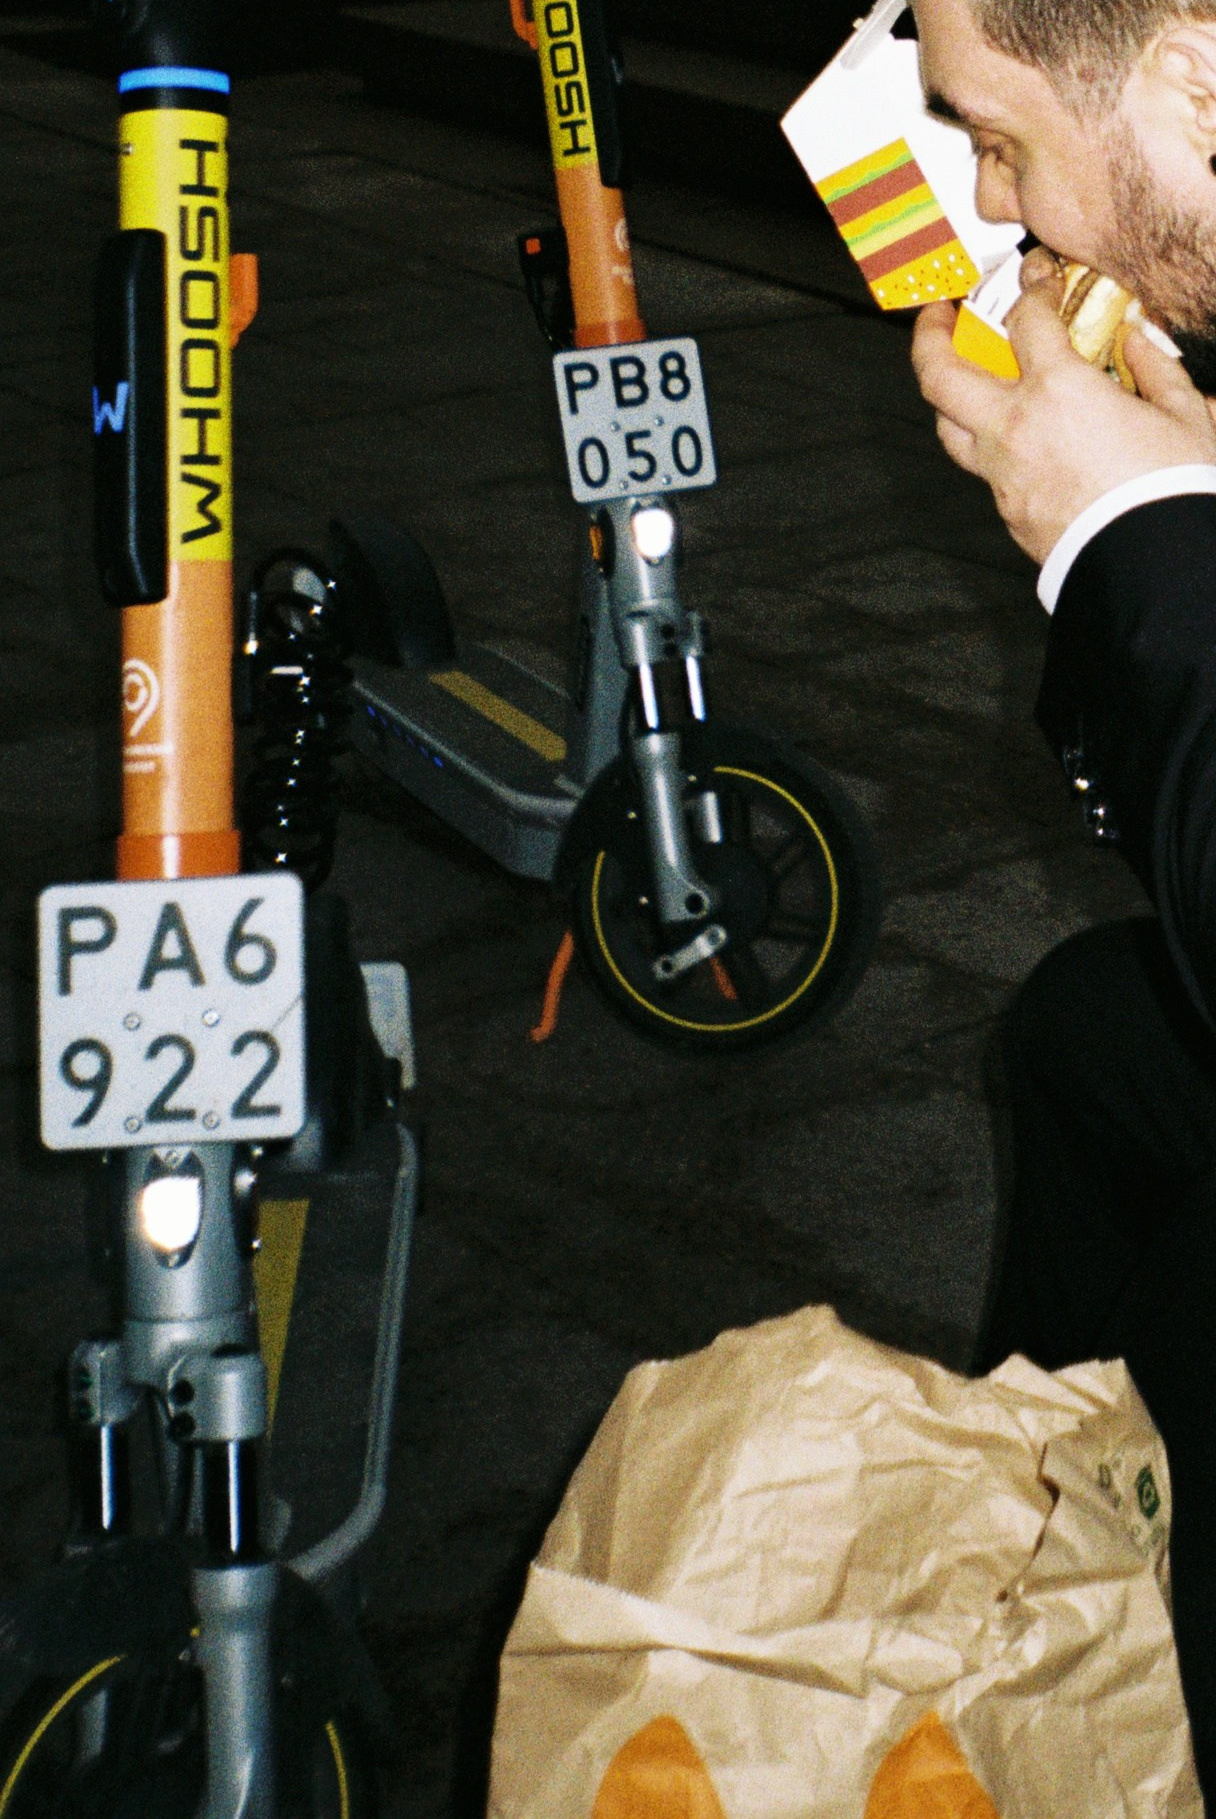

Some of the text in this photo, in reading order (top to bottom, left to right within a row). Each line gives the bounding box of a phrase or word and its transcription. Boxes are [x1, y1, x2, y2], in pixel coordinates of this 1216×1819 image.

[178, 138, 223, 543] WHOOSH
[92, 381, 129, 434] W
[563, 350, 691, 415] PB8
[577, 425, 703, 489] 050
[58, 898, 277, 996] PA6
[60, 1030, 281, 1128] 922
